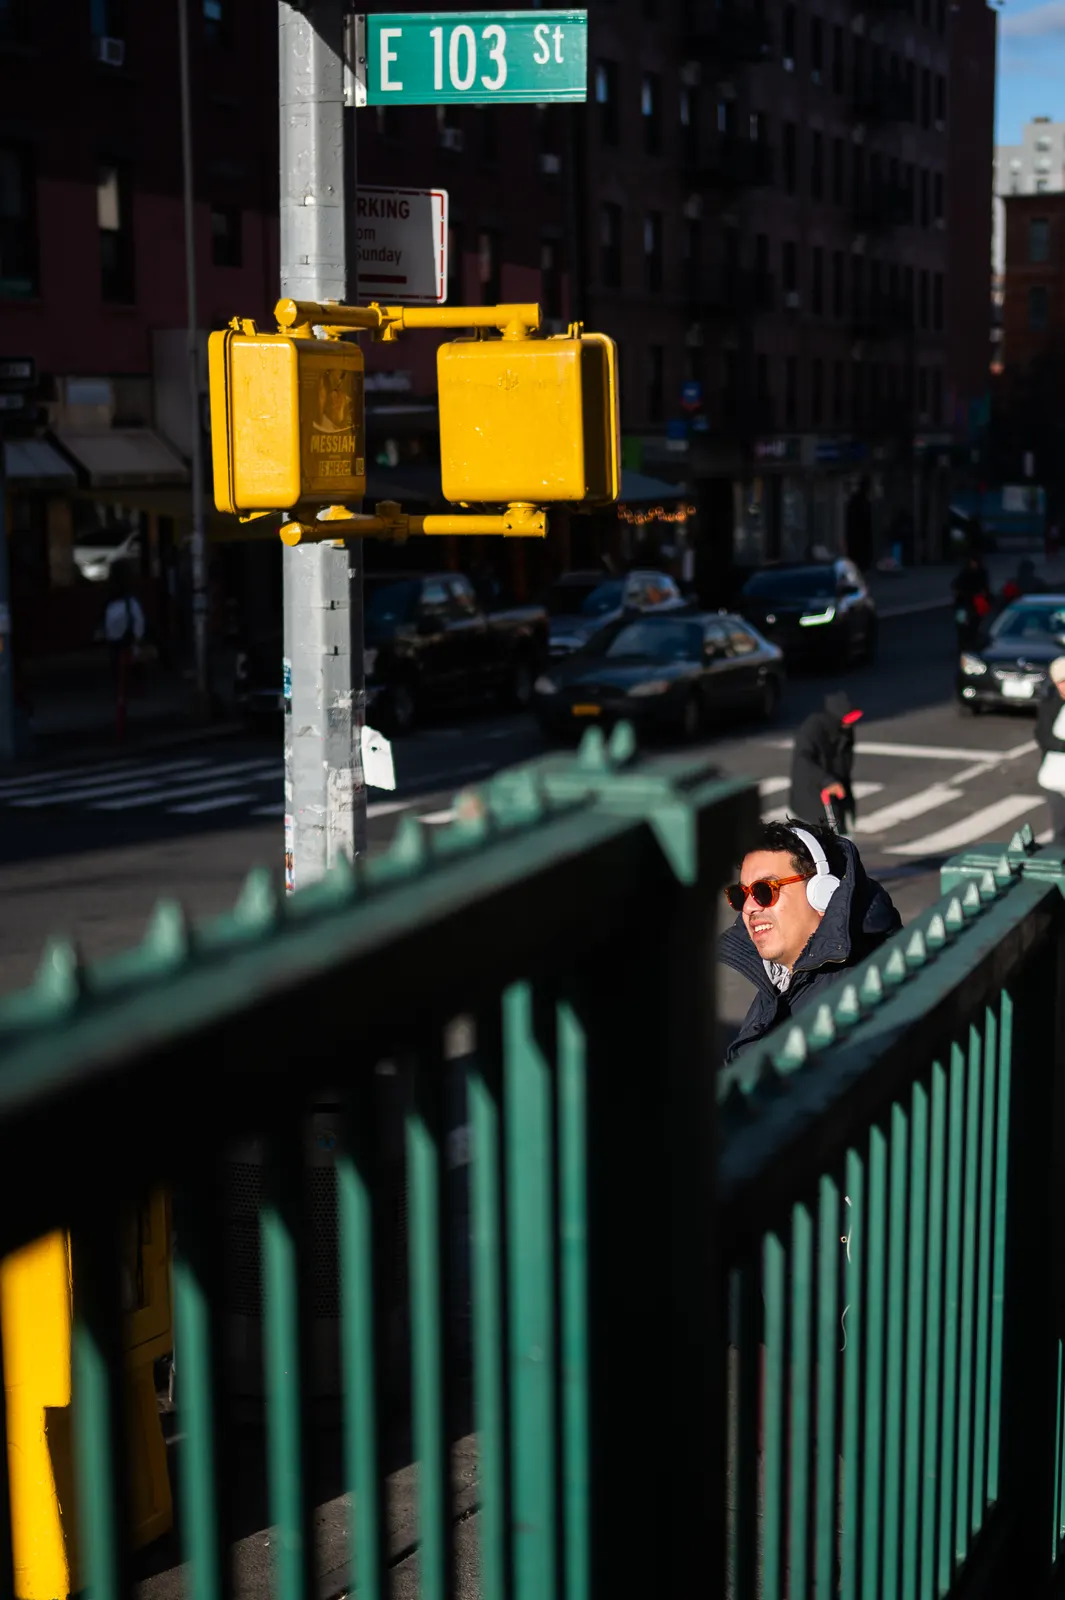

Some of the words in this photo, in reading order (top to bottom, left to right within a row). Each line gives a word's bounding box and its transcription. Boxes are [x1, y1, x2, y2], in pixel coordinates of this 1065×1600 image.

[380, 28, 403, 91] E
[430, 24, 508, 91] 103
[533, 23, 565, 65] St
[310, 435, 356, 453] MESSIAH
